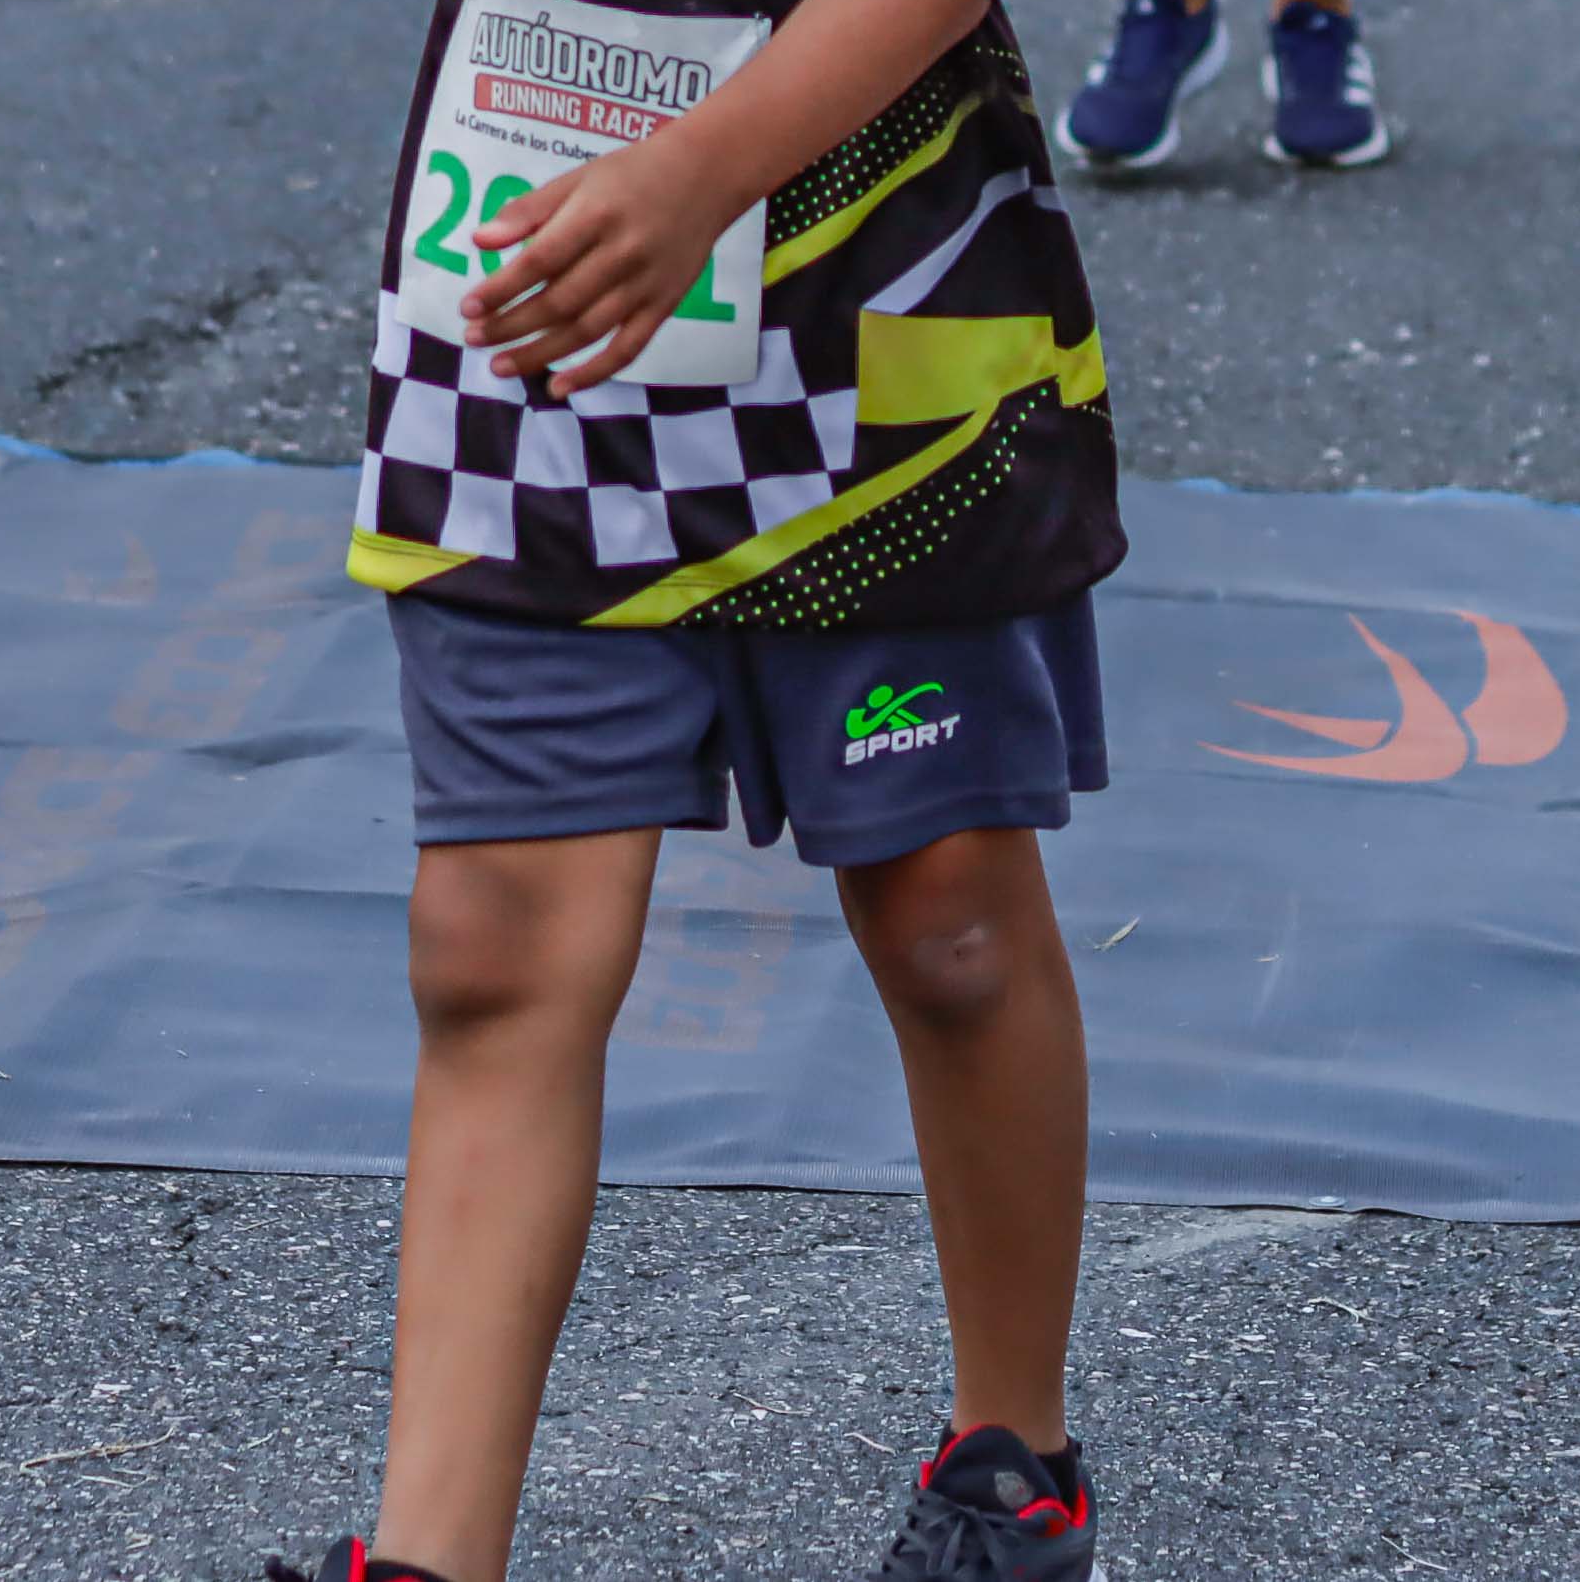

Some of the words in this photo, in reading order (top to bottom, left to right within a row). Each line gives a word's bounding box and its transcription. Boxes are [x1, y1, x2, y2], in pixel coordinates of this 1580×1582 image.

[469, 11, 711, 111] AUTÓDROMO
[468, 115, 508, 141] Carrera
[511, 129, 526, 146] de
[530, 134, 548, 152] los
[490, 80, 582, 125] RUNNING
[589, 107, 657, 143] RACE
[844, 714, 961, 766] SPORT
